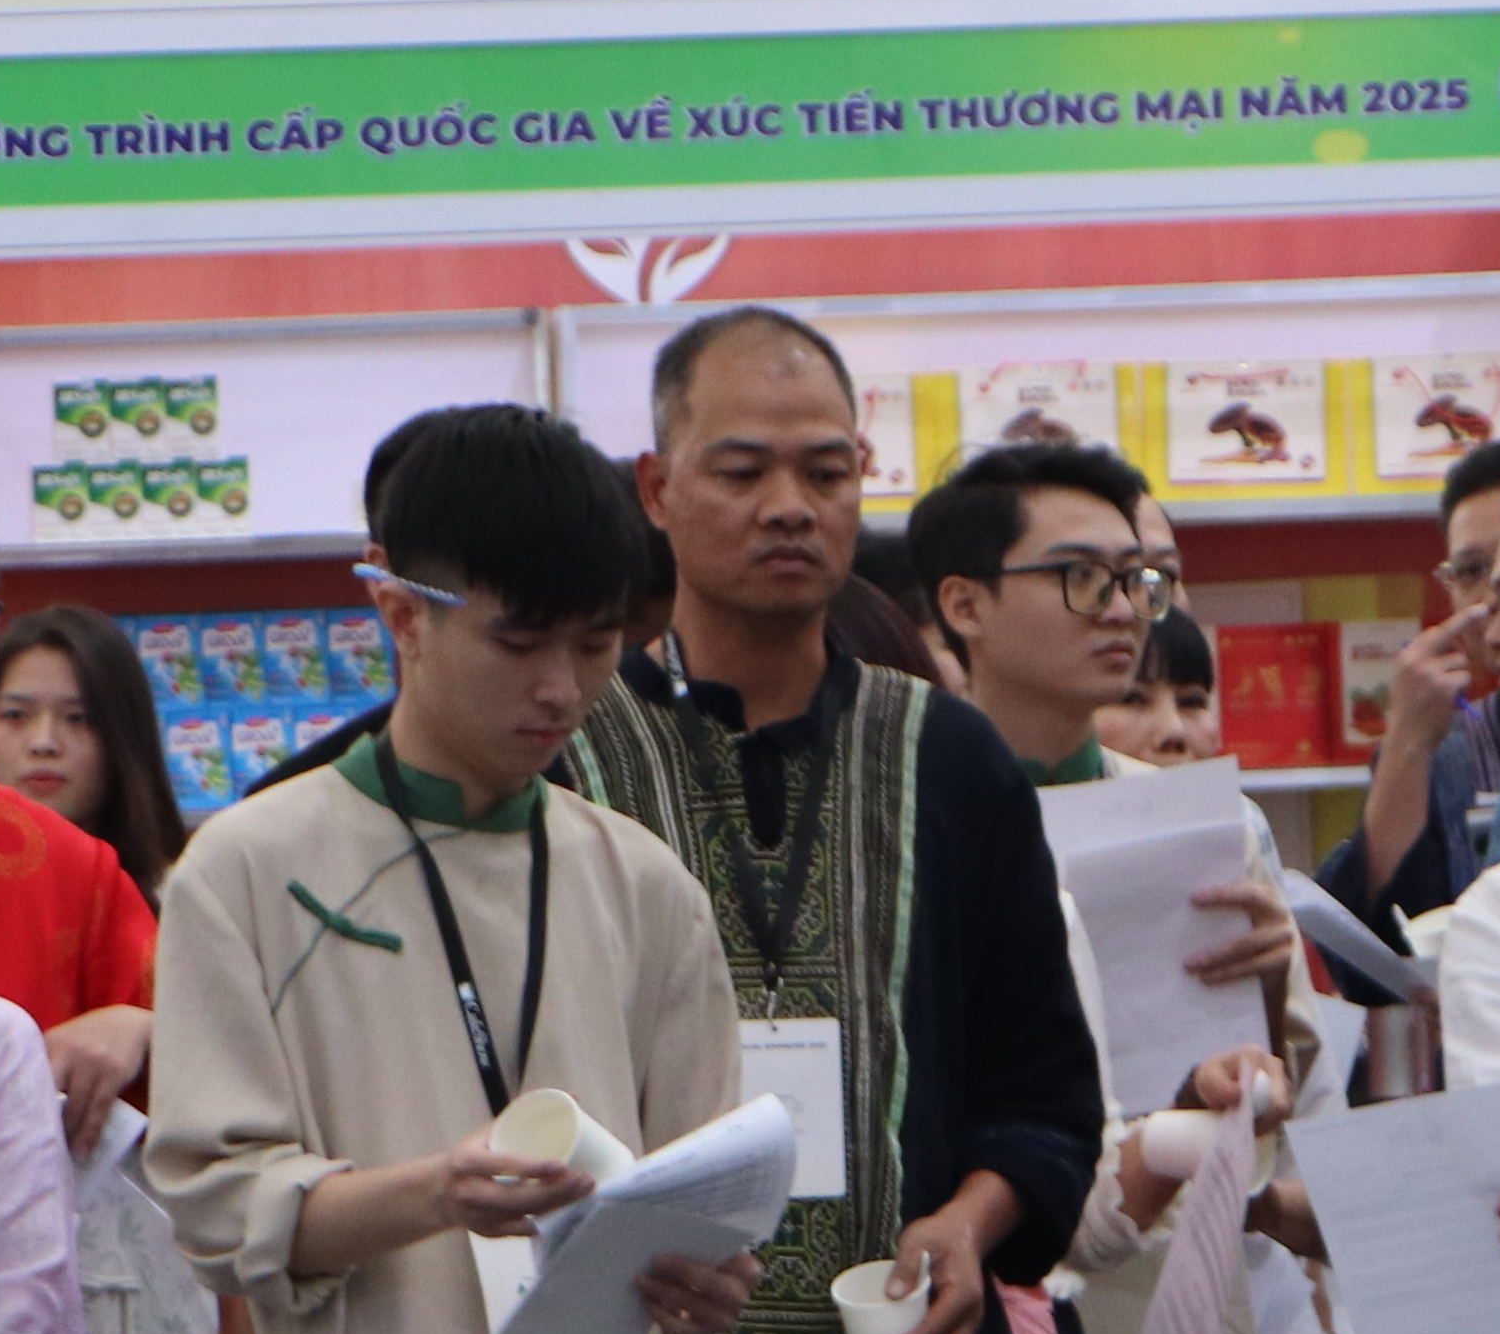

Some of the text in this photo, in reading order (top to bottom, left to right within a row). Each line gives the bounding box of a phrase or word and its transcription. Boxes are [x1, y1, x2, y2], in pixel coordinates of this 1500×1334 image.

[85, 114, 231, 156] TRÌNH
[246, 106, 344, 153] CẤP
[361, 99, 499, 155] QUỐC
[513, 111, 596, 143] GIA
[608, 96, 672, 140] VỀ
[685, 97, 783, 139] XÚC
[797, 88, 904, 134] TIẾN
[919, 88, 1120, 129] THƯƠNG
[1135, 87, 1224, 133] MẠI
[1241, 76, 1348, 116] NĂM
[1362, 78, 1469, 113] 2025
